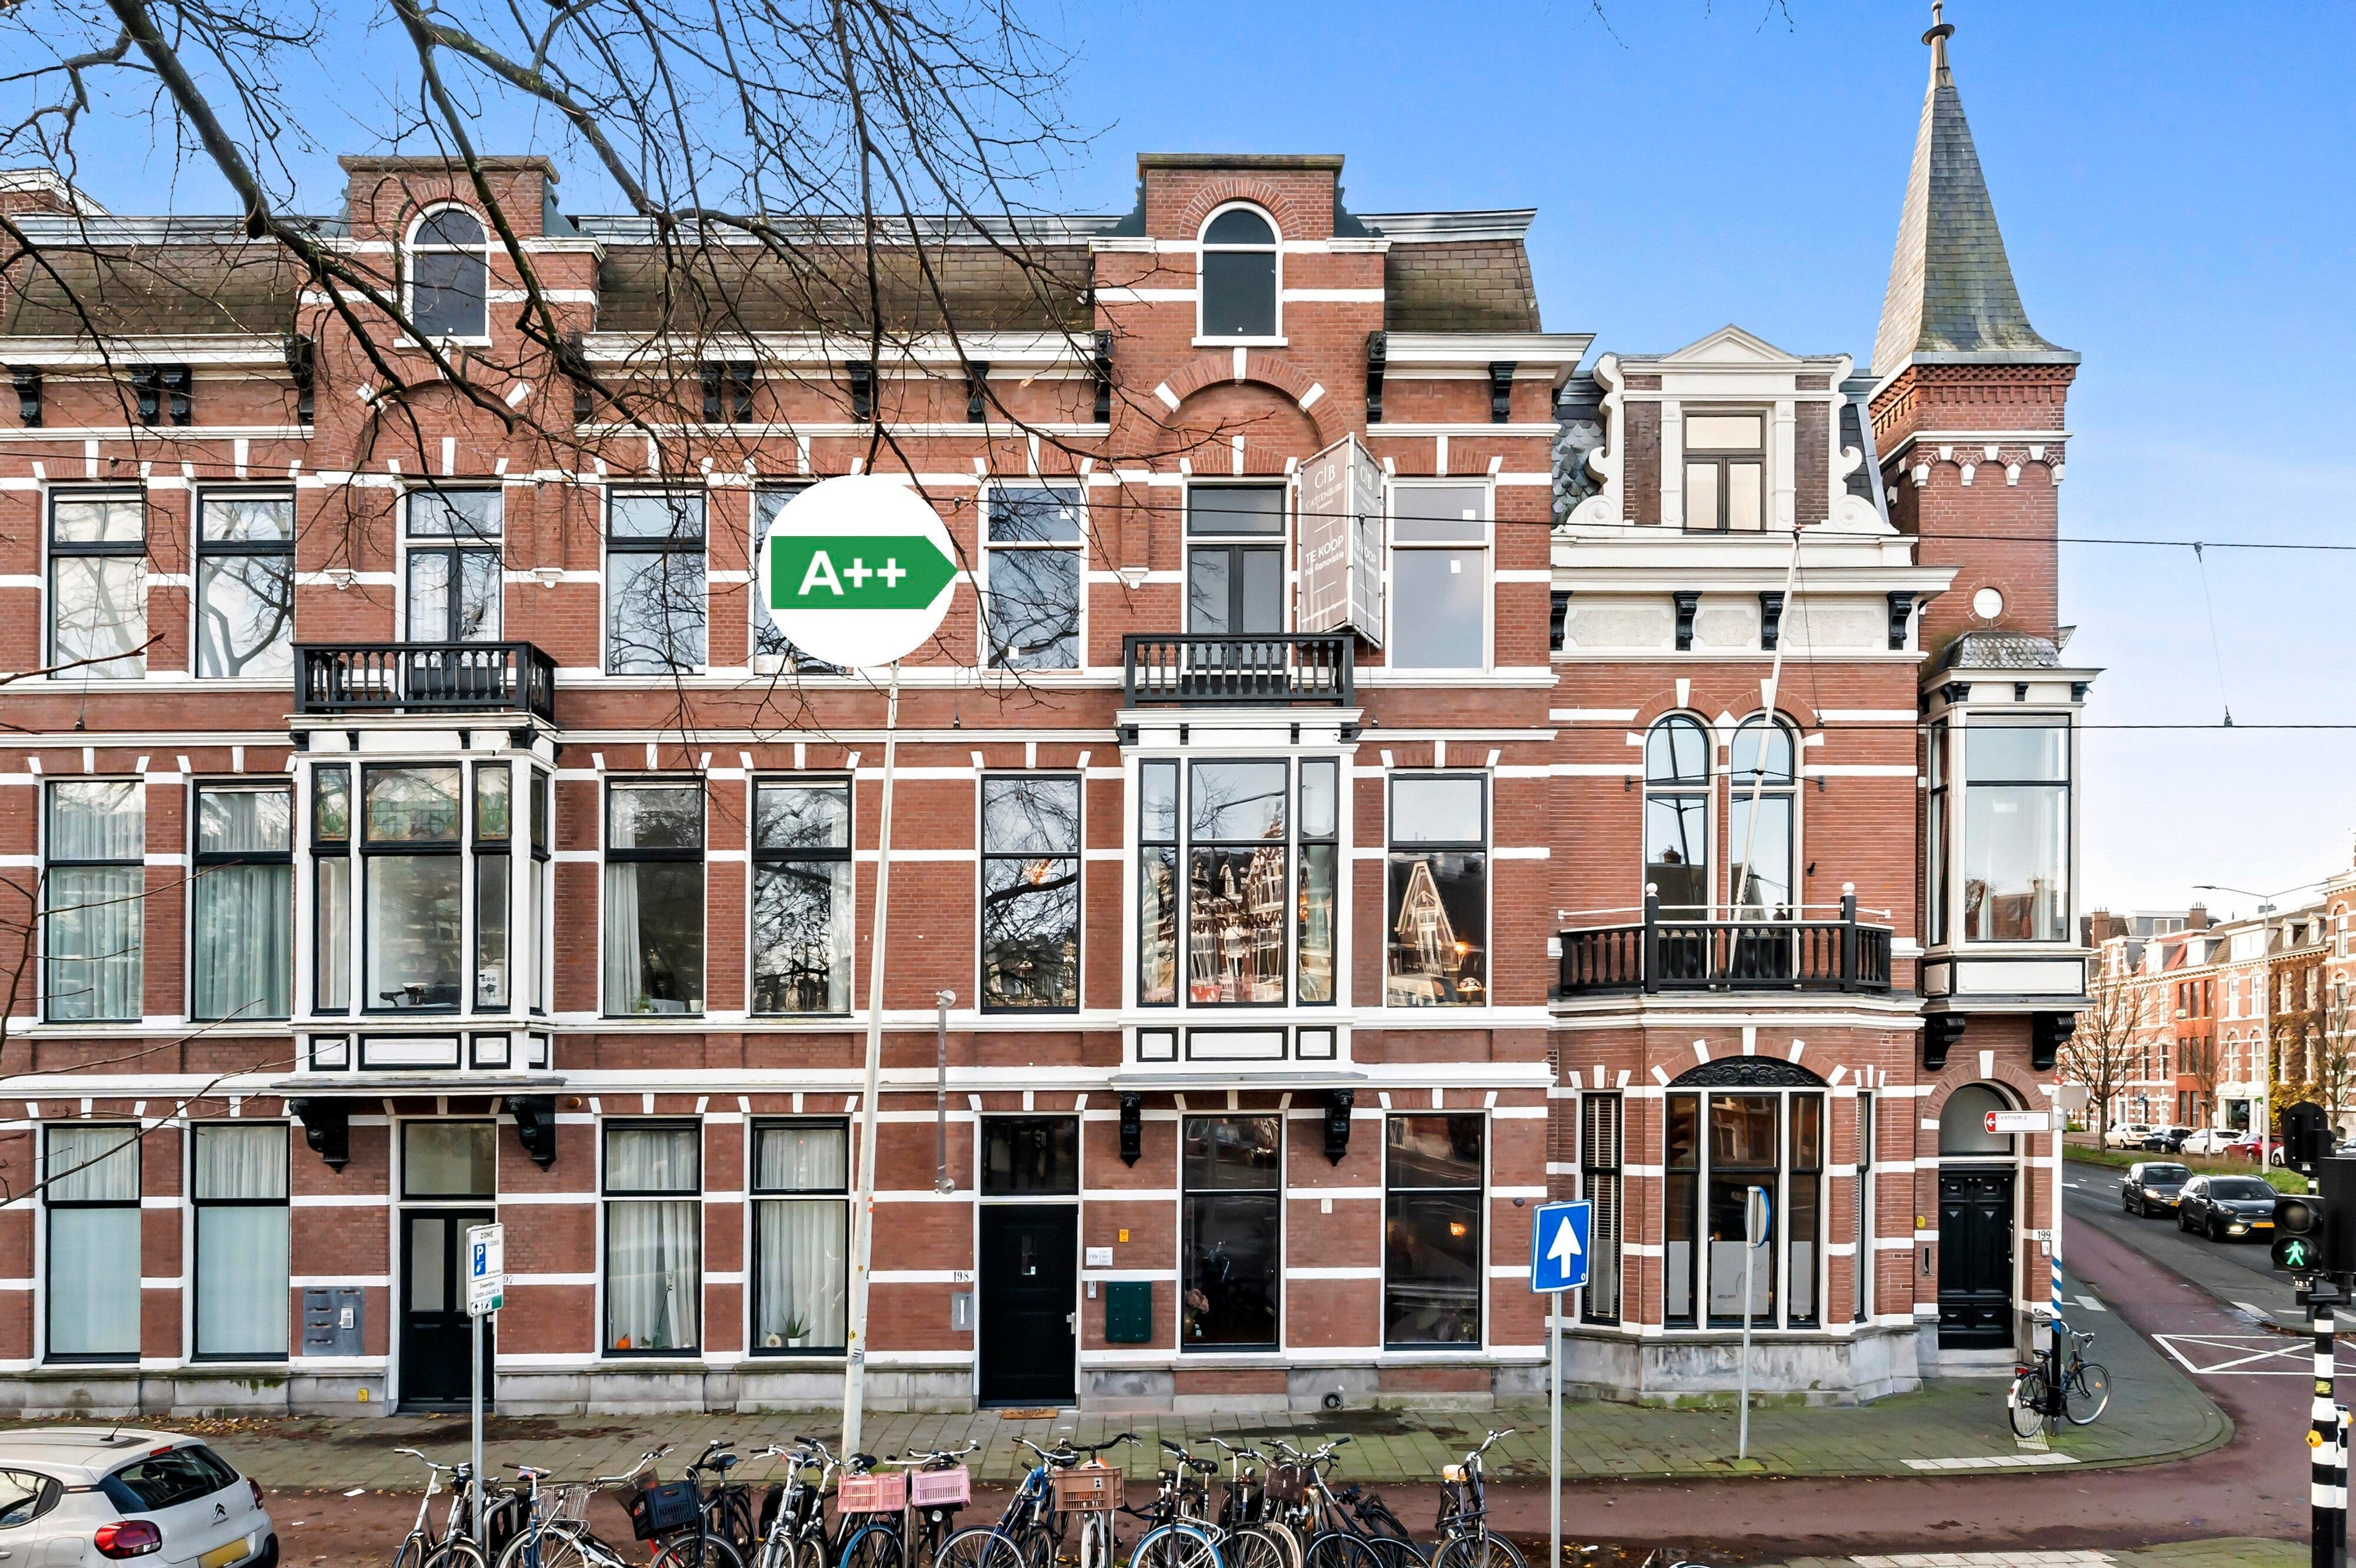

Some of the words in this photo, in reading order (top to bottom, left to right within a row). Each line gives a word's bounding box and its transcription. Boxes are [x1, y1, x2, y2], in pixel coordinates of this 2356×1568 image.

[1305, 550, 1317, 564] TE
[1319, 534, 1344, 558] KOOP
[480, 1231, 494, 1239] ZONE
[2038, 1230, 2051, 1240] 199
[477, 1245, 484, 1261] P
[503, 1275, 514, 1284] 97
[953, 1270, 969, 1282] 198
